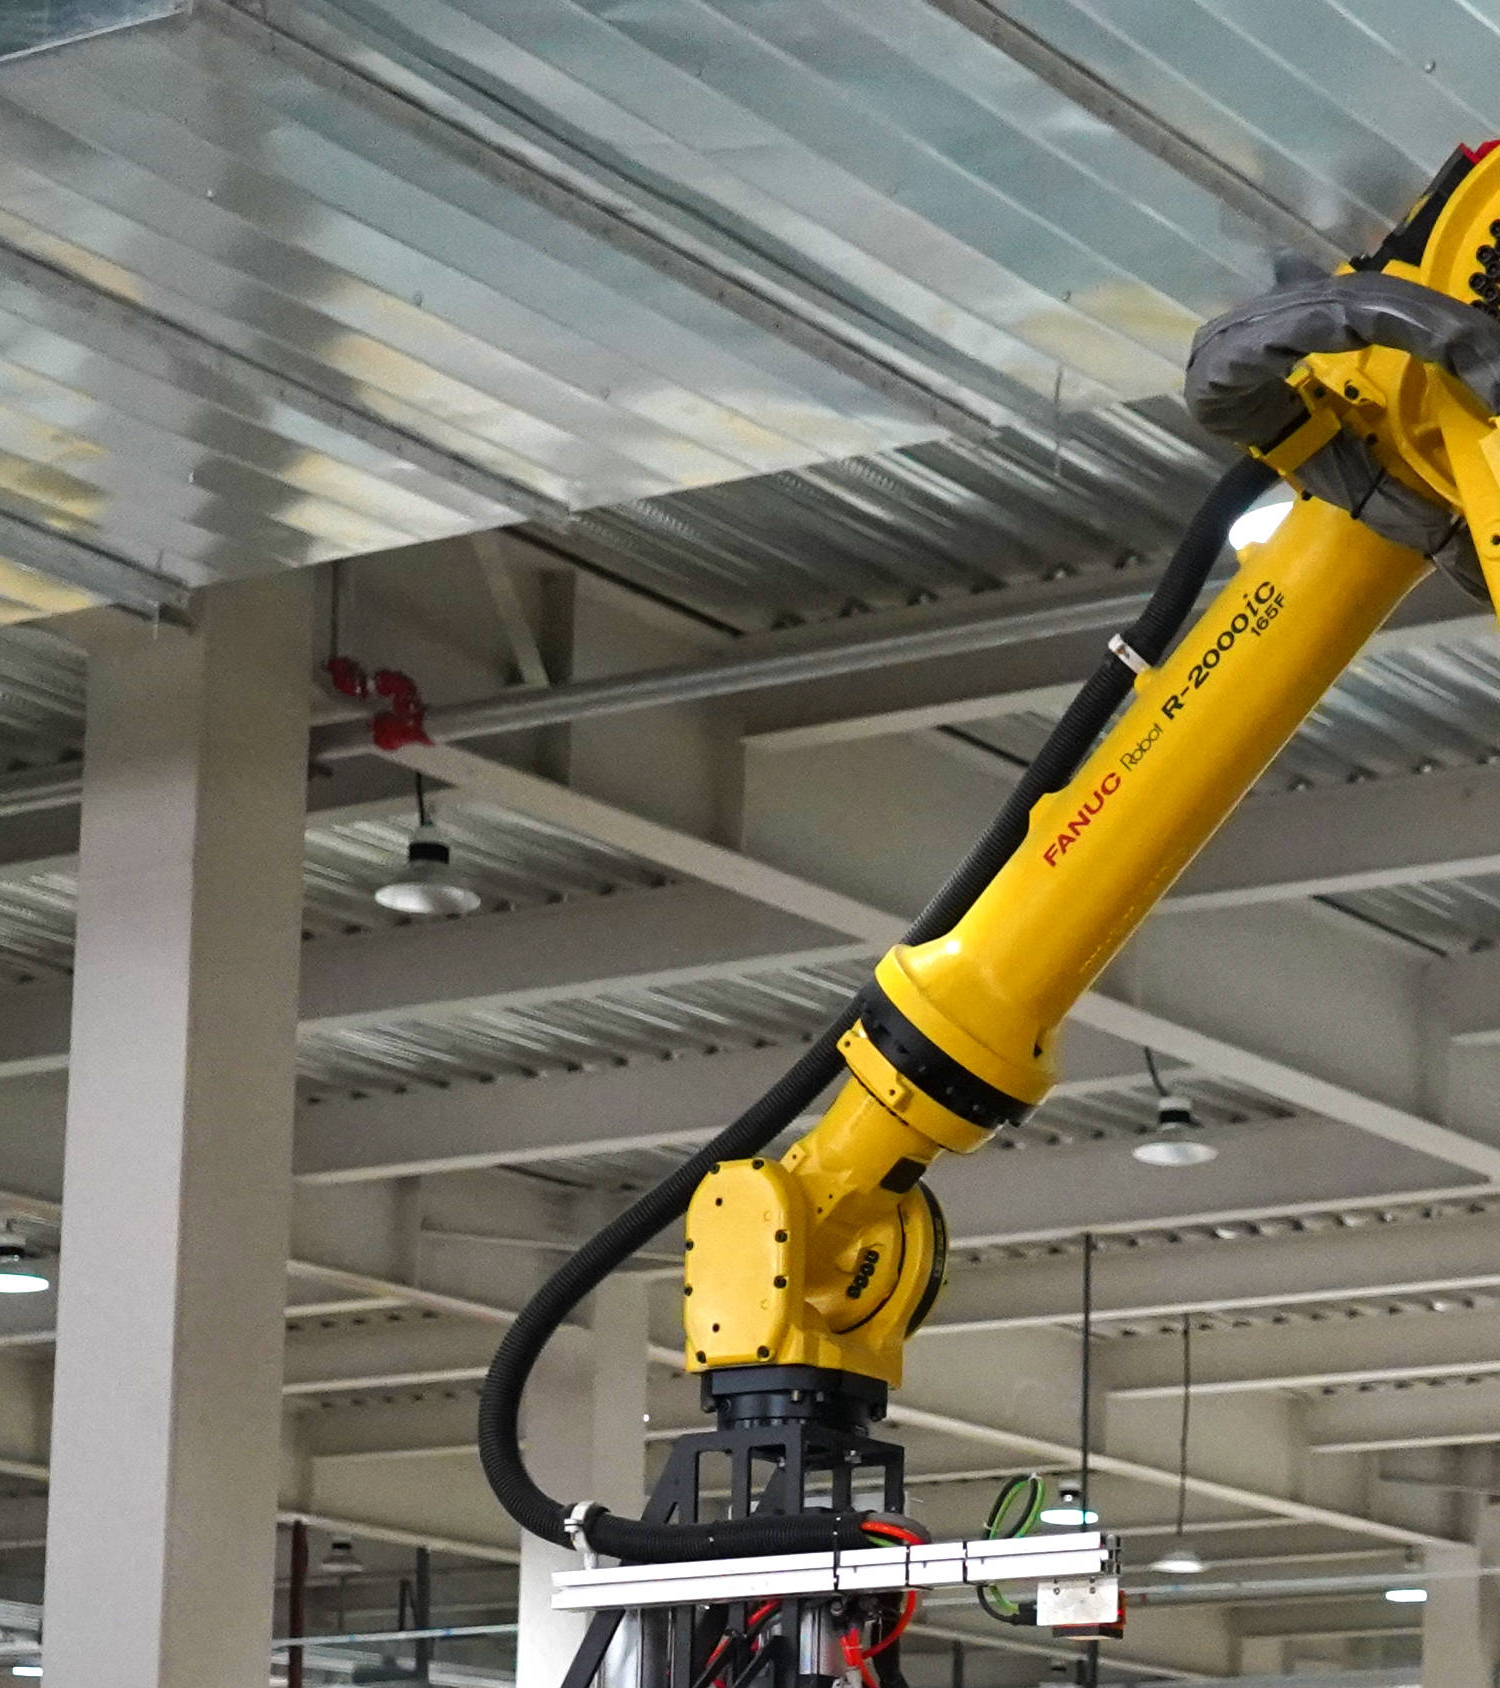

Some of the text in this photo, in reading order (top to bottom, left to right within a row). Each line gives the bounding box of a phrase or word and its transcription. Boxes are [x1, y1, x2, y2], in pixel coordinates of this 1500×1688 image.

[1251, 592, 1287, 637] 165F
[1042, 580, 1275, 868] FANUC Robot R-2000iC
